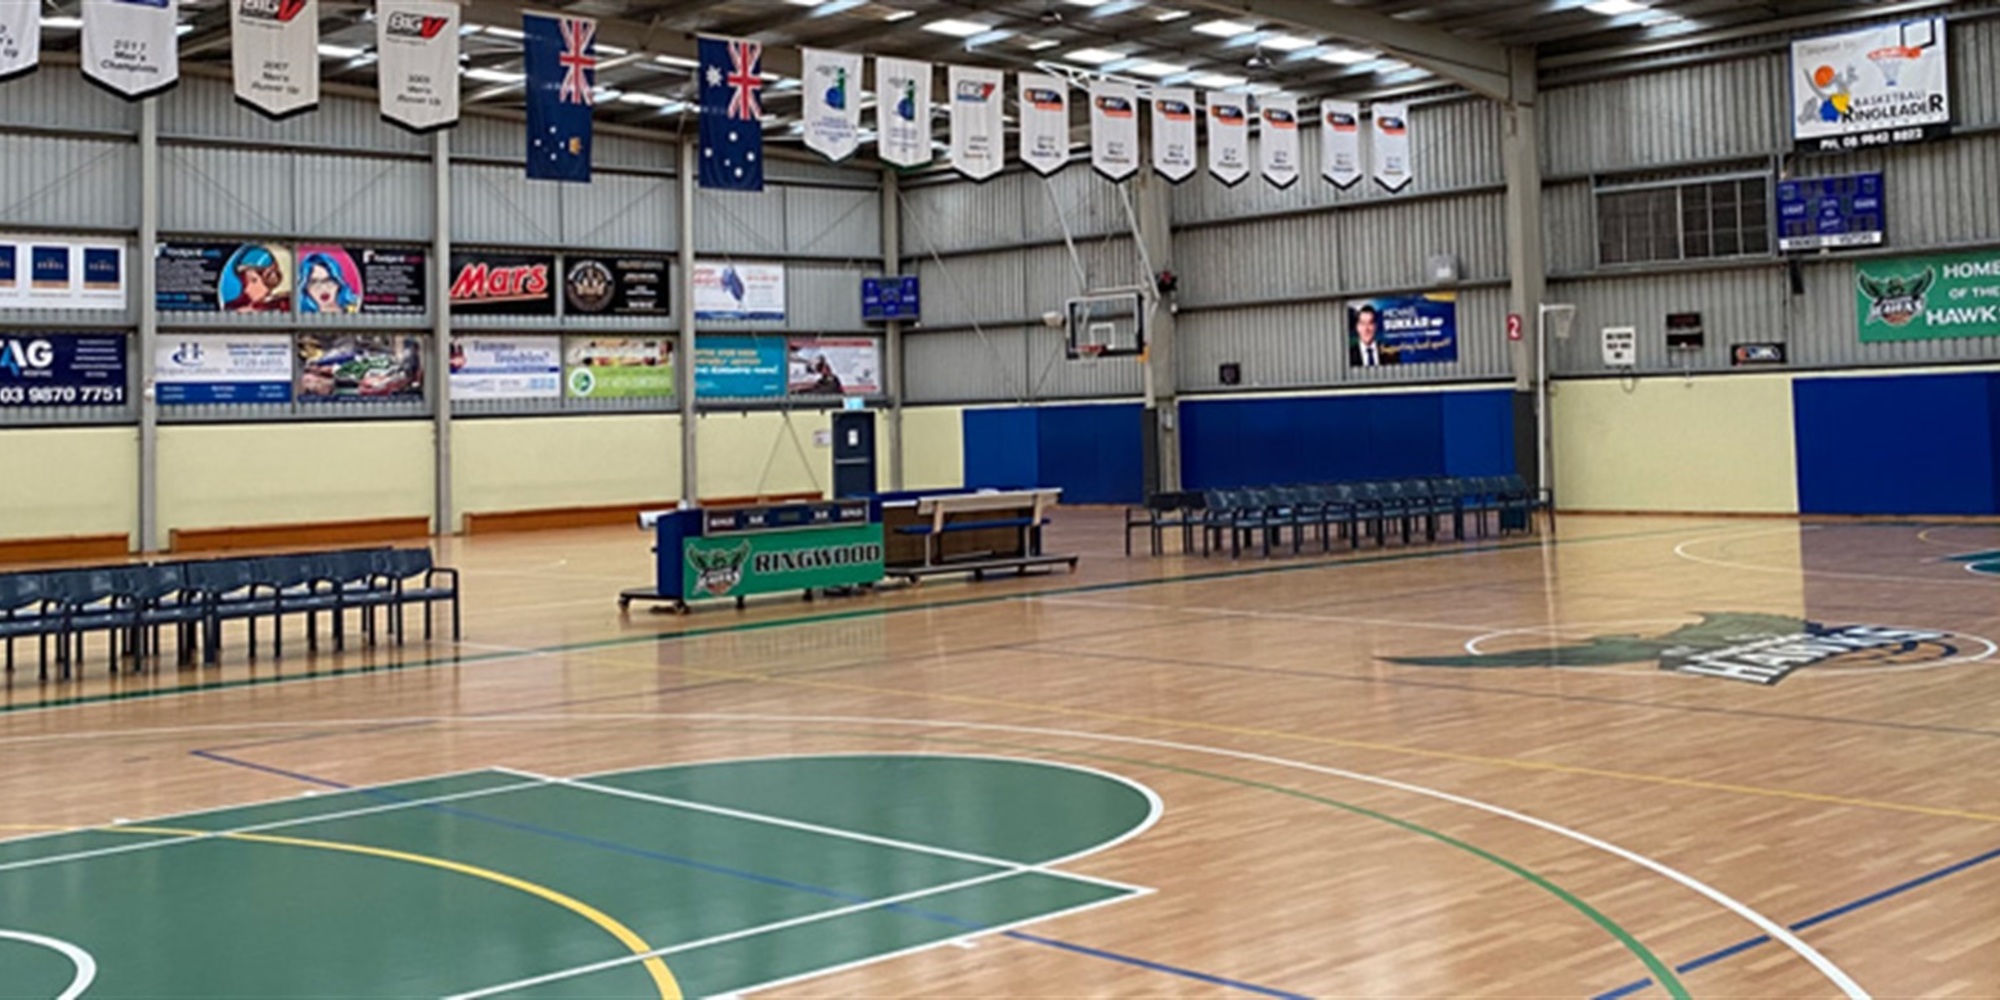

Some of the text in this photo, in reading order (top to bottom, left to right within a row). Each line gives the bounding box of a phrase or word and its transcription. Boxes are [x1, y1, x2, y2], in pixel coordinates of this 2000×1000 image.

[1841, 93, 1945, 124] RINGLEADER
[1854, 90, 1927, 107] BASKETBALL
[450, 262, 548, 298] Mars
[1943, 261, 2000, 279] HOME
[1510, 316, 1519, 338] 2
[0, 386, 122, 403] 03 9870 7751
[753, 544, 882, 575] RINGWOOD
